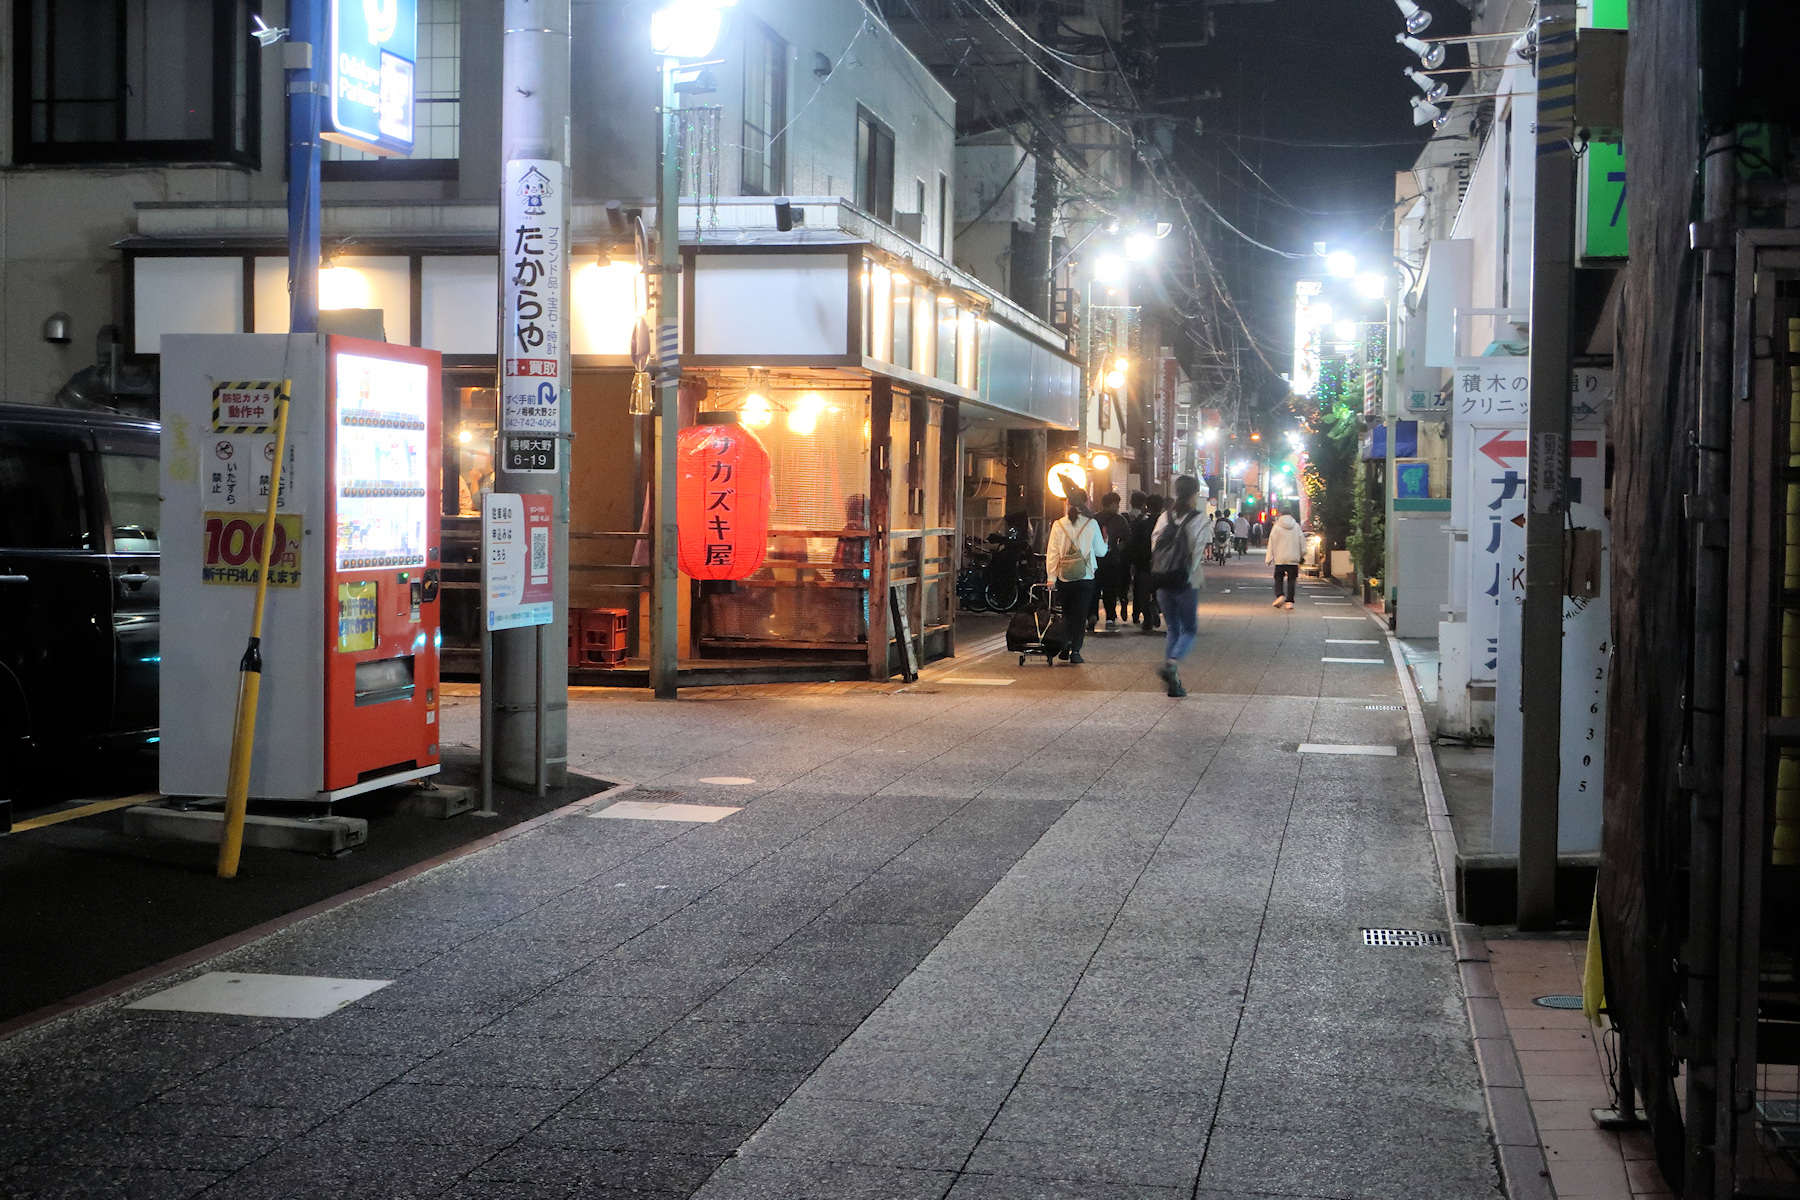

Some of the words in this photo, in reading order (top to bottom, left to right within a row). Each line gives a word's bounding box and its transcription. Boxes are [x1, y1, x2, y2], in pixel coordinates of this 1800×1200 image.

[515, 224, 545, 353] たからや
[506, 360, 557, 376] 質・買取
[222, 393, 270, 403] 防犯カメラ
[506, 394, 537, 405] すぐ手前
[228, 406, 264, 418] 動作中
[506, 418, 557, 428] 042-742-4064
[510, 440, 552, 451] 相模大野
[514, 455, 547, 466] 6-19
[212, 473, 222, 494] 禁止
[260, 475, 270, 496] 禁止
[704, 436, 736, 566] サカズキ屋
[205, 517, 287, 567] 100
